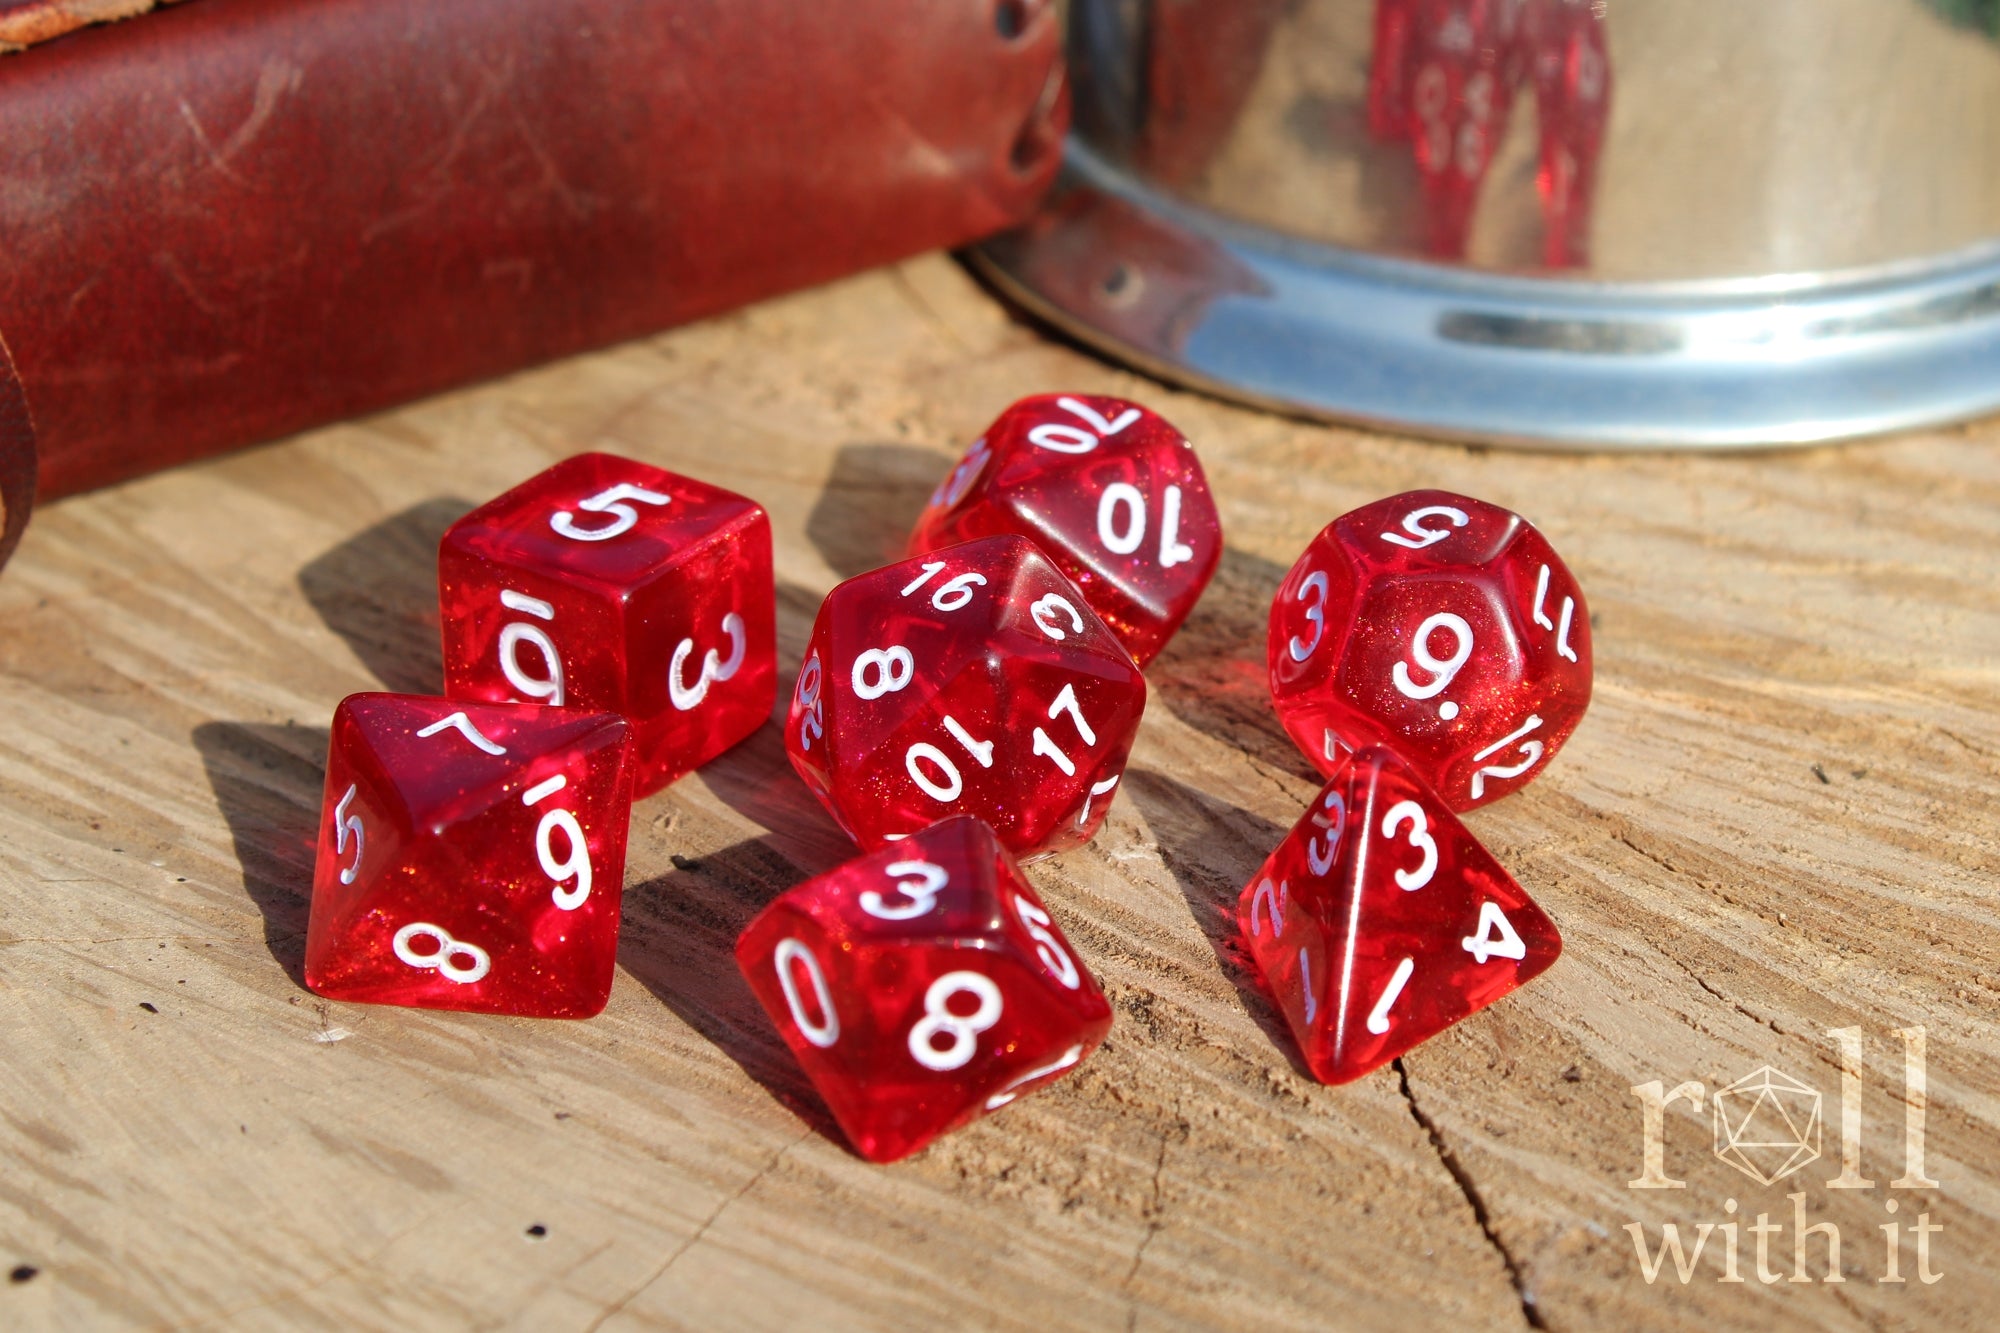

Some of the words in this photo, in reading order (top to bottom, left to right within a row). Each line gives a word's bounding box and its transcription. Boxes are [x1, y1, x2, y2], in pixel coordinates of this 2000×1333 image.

[1028, 397, 1142, 454] 70
[550, 483, 671, 541] 5
[1097, 482, 1193, 567] 10
[1380, 506, 1469, 549] 5
[900, 561, 987, 611] 16
[1030, 593, 1084, 640] 3
[1289, 570, 1329, 661] 3
[1533, 564, 1577, 662] 11
[669, 613, 746, 710] 3
[800, 656, 823, 751] 20
[851, 645, 914, 700] 8
[416, 712, 507, 755] 7
[905, 715, 994, 802] 10
[1033, 683, 1096, 777] 17
[1471, 715, 1544, 800] 12
[335, 784, 364, 885] 5
[1309, 791, 1345, 876] 3
[1382, 800, 1438, 891] 3
[859, 860, 949, 920] 3
[1252, 877, 1287, 938] 2
[392, 922, 491, 983] 8
[1014, 893, 1080, 990] 5
[1461, 902, 1526, 964] 4
[774, 937, 840, 1048] 0
[908, 970, 1004, 1071] 8
[1366, 957, 1414, 1035] 1
